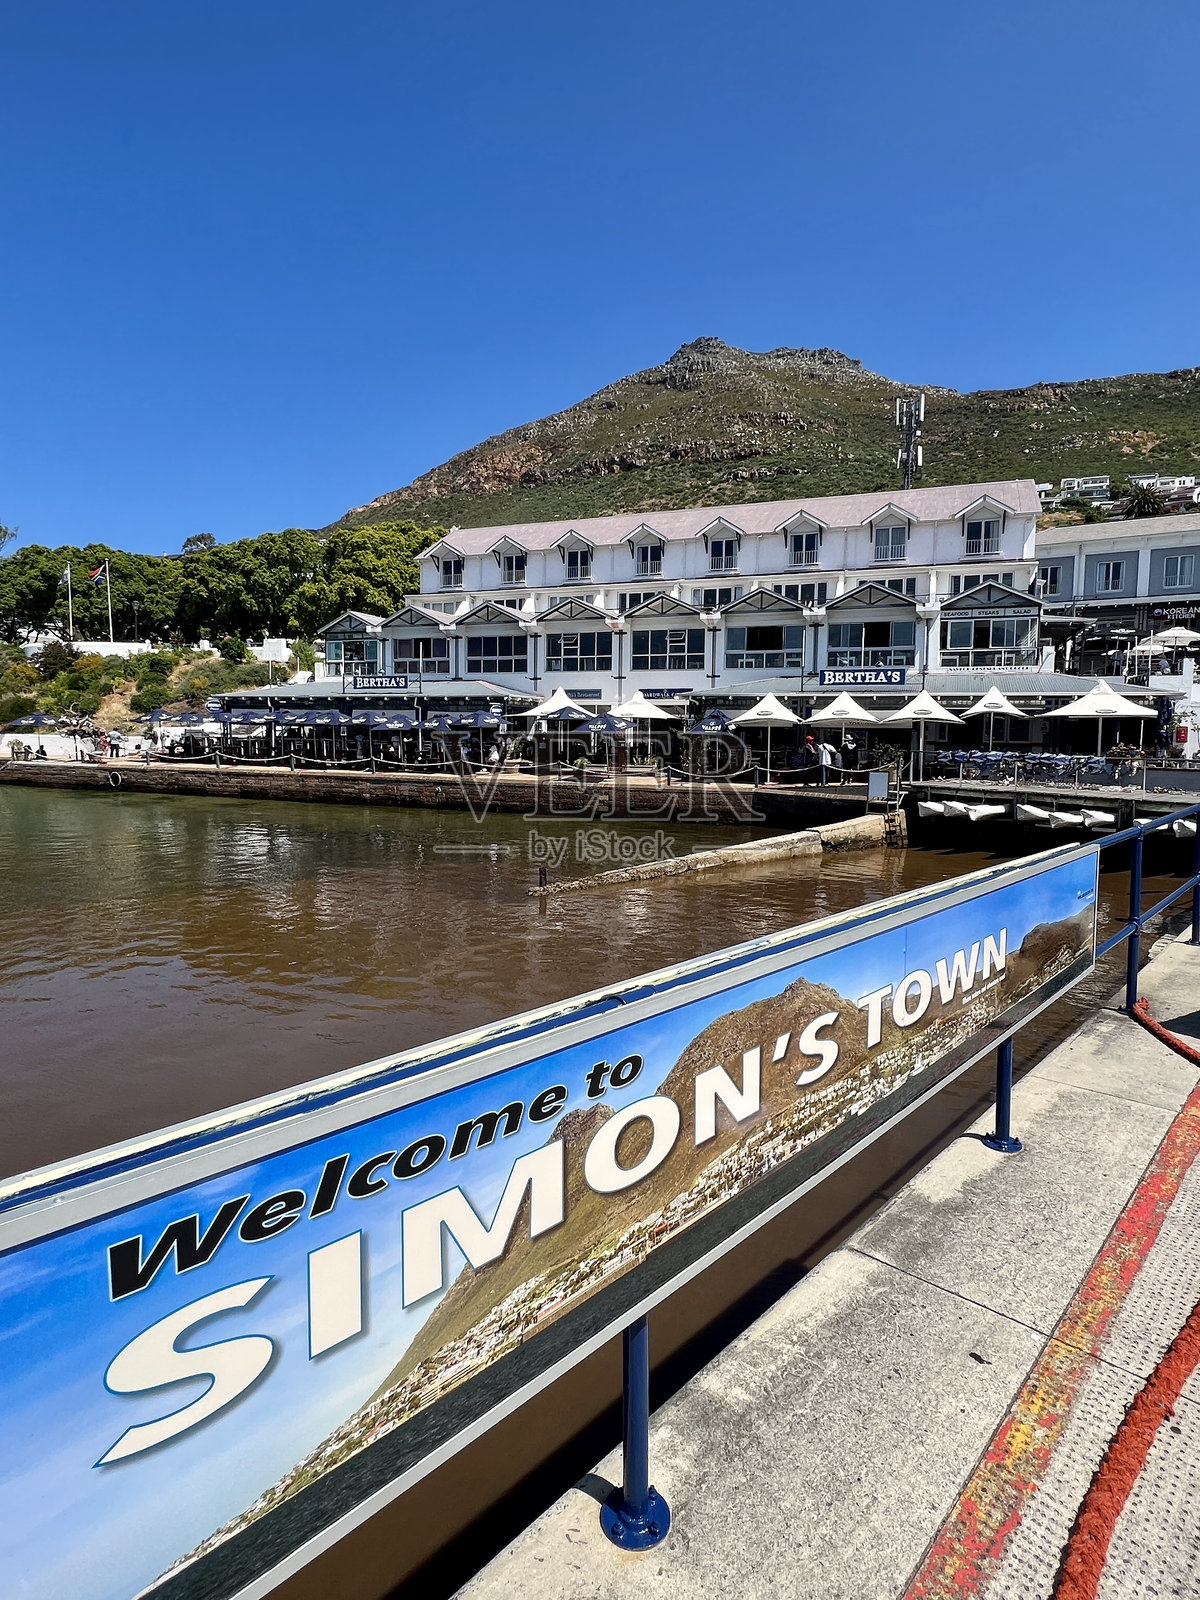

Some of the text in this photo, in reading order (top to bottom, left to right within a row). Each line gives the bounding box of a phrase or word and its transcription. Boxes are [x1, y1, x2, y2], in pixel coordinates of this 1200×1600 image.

[1163, 607, 1200, 615] KOREAN
[356, 677, 406, 688] BERTHA'S
[823, 671, 901, 684] BERTHA'S
[107, 1053, 644, 1303] Welcome to
[91, 927, 1008, 1469] SIMON'S TOWN
